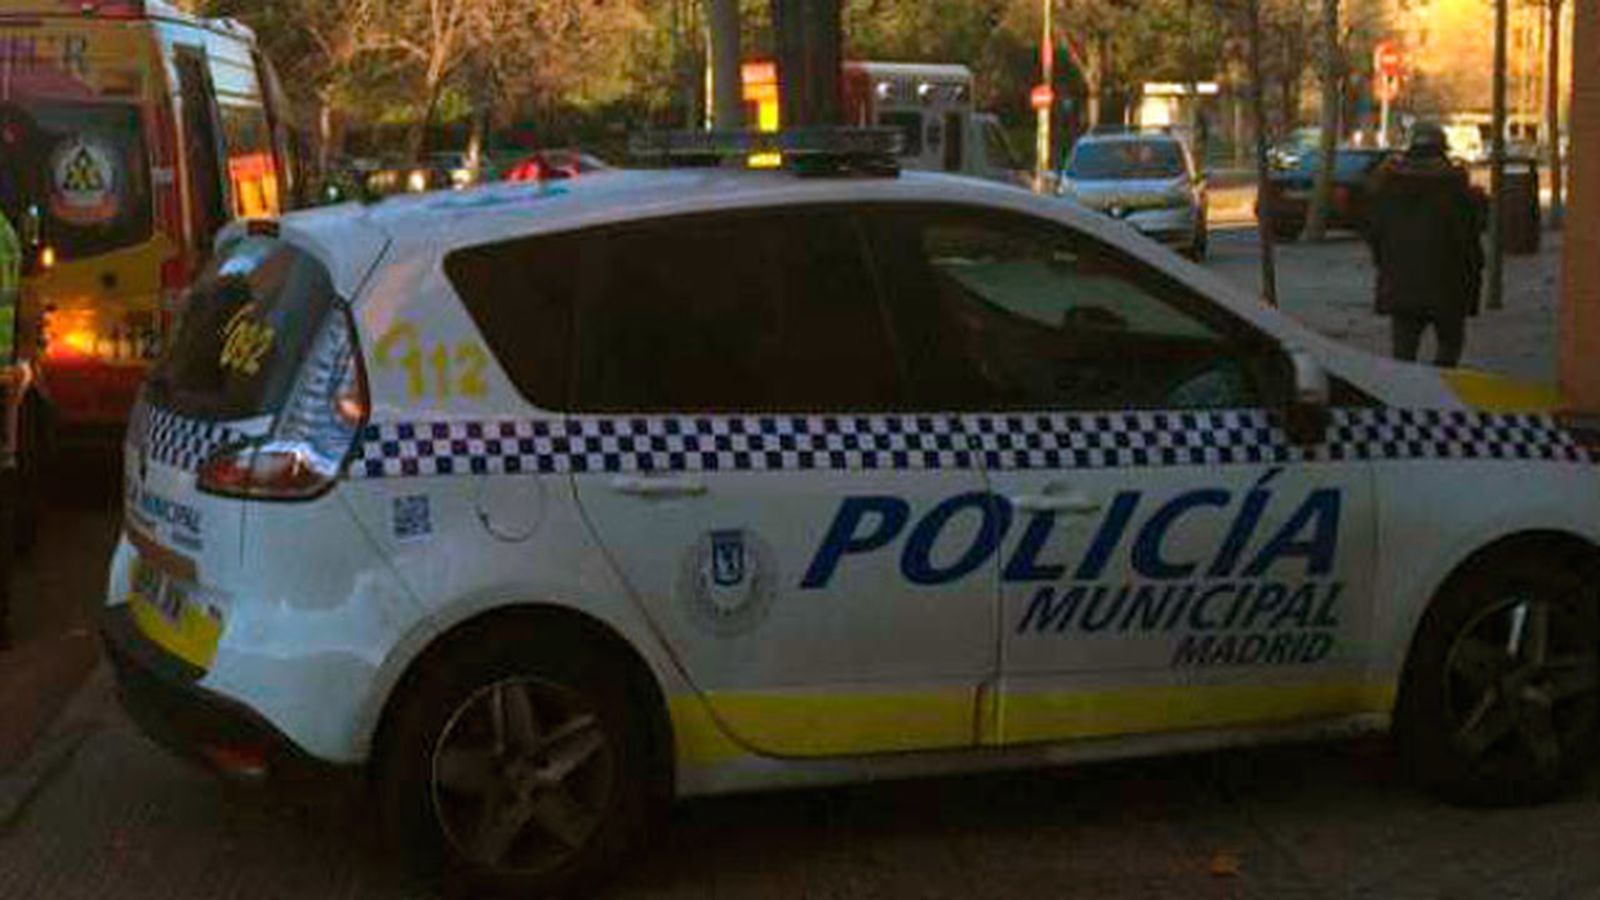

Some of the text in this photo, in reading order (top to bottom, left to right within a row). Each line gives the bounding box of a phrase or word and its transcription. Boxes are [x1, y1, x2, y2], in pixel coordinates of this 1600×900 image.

[800, 467, 1342, 589] POLICÍA
[1017, 582, 1344, 634] MUNICIPAL
[1171, 631, 1335, 667] MADRID
